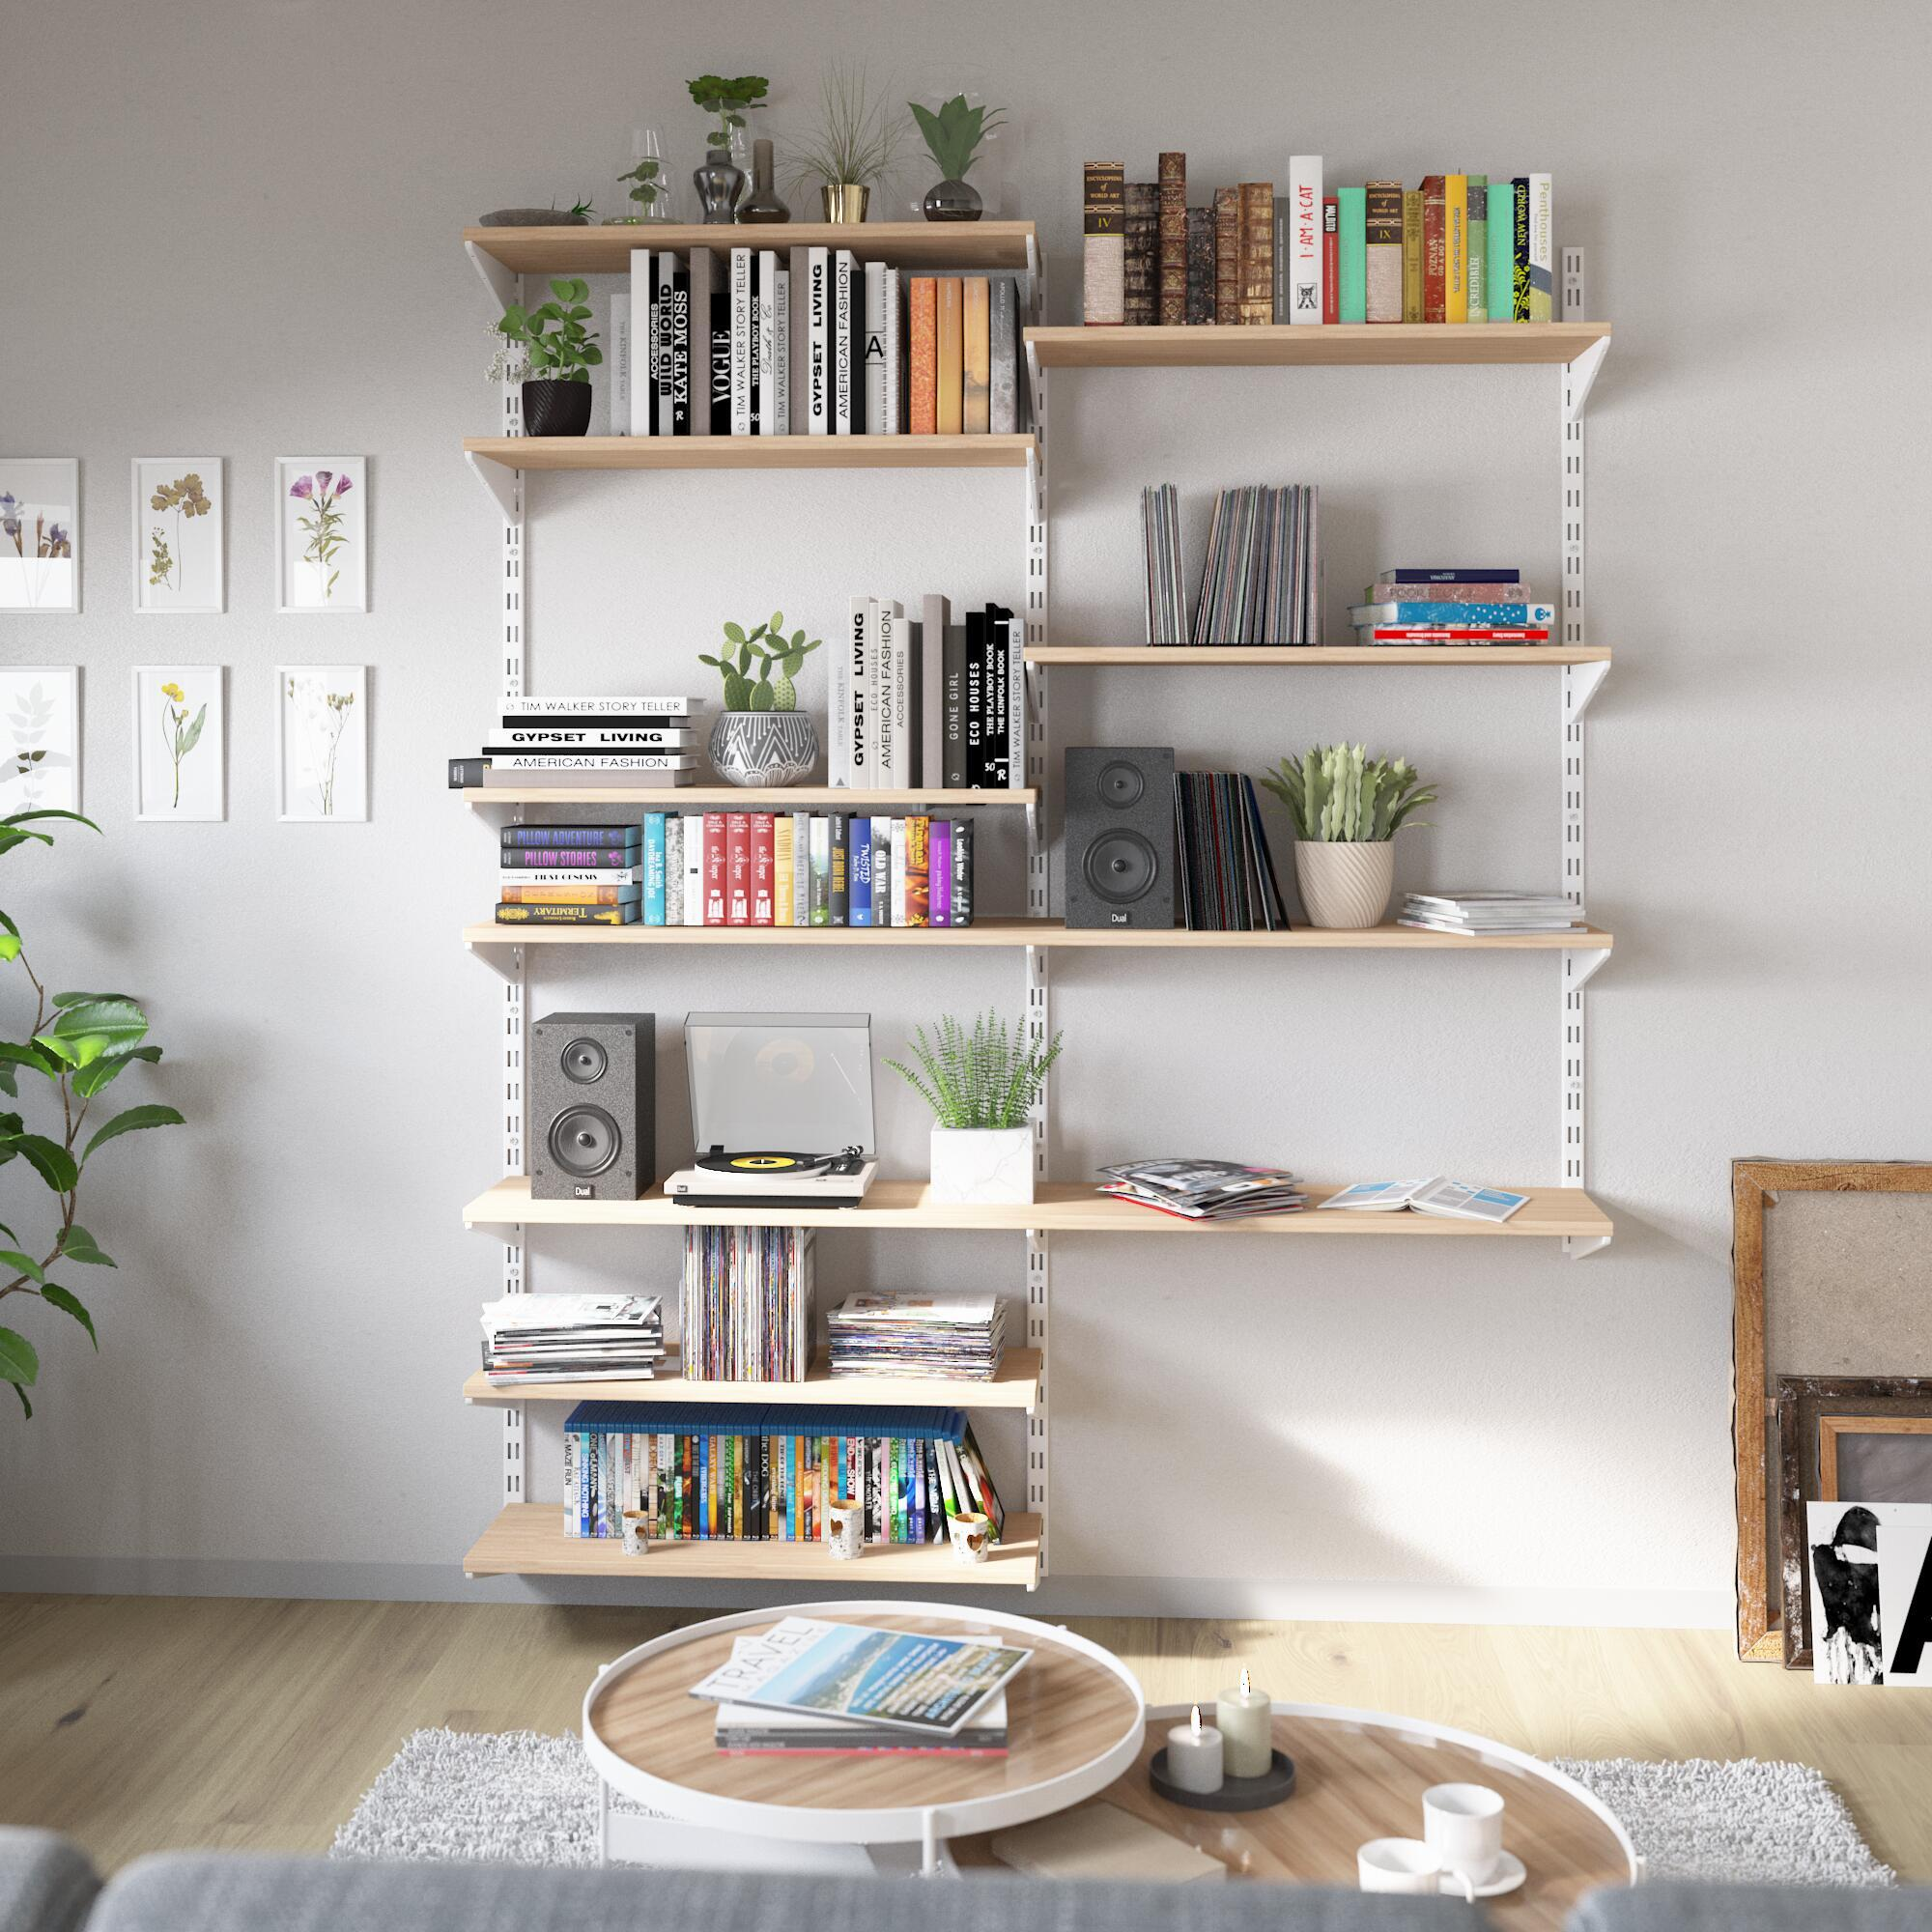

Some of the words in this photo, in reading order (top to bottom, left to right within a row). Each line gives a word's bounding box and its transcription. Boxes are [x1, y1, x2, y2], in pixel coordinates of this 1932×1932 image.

[1298, 185, 1314, 208] CAT
[1517, 185, 1526, 222] WORLD
[1098, 216, 1112, 228] IV
[1379, 230, 1391, 240] IX
[1517, 221, 1526, 246] NEW
[1539, 182, 1551, 262] Penthouses
[736, 254, 747, 294] TELLER
[777, 282, 786, 317] TELLER
[812, 264, 823, 327] LIVING
[838, 262, 849, 329] FASHION
[660, 283, 672, 347] WORLD
[673, 290, 689, 347] MOSS
[736, 298, 747, 338] STORY
[650, 302, 659, 381] ACCESSORIES
[777, 320, 786, 353] STORY
[866, 335, 885, 359] A
[660, 353, 672, 397] WILD
[673, 351, 689, 405] KATE
[712, 329, 731, 406] VOGUE
[736, 340, 747, 391] WALKER
[777, 355, 786, 398] WALKER
[812, 341, 823, 416] GYPSET
[838, 335, 849, 418] AMERICAN
[736, 394, 747, 416] TIM
[777, 401, 786, 418] TIM
[854, 611, 865, 676] LIVING
[881, 611, 892, 680] FASHION
[986, 643, 995, 670] BOOK
[1012, 631, 1022, 665] TELLER
[997, 649, 1006, 674] BOOK
[969, 662, 980, 712] HOUSES
[986, 670, 995, 715] PLAYBOY
[997, 676, 1006, 715] KINFOLK
[1012, 668, 1022, 701] STORY
[521, 701, 541, 711] TIM
[545, 701, 595, 711] WALKER
[598, 701, 638, 711] STORY
[641, 701, 680, 711] TELLER
[511, 733, 587, 742] GYPSET
[599, 733, 663, 742] LIVING
[854, 690, 865, 767] GYPSET
[881, 685, 892, 769] AMERICAN
[949, 706, 959, 741] GONE
[969, 721, 980, 746] ECO
[986, 716, 995, 736] THE
[997, 717, 1006, 735] THE
[1012, 705, 1022, 748] WALKER
[513, 757, 595, 768] AMERICAN
[600, 757, 668, 768] FASHION
[984, 762, 995, 772] 50
[1012, 751, 1022, 768] TIM
[517, 831, 551, 846] PILLOW
[553, 831, 605, 846] ADVENTURE
[525, 851, 557, 867] PILLOW
[559, 851, 598, 867] STORIES
[860, 843, 871, 884] TWISTED
[875, 850, 887, 869] OLD
[875, 871, 887, 894] WAR
[1112, 913, 1127, 923] Dual
[575, 1186, 590, 1196] Dual
[589, 1433, 598, 1450] ONE
[709, 1435, 718, 1468] GALAXY
[846, 1437, 855, 1456] END
[846, 1468, 855, 1495] SHOW
[927, 1468, 936, 1485] THE
[706, 1627, 815, 1689] TRAVEL
